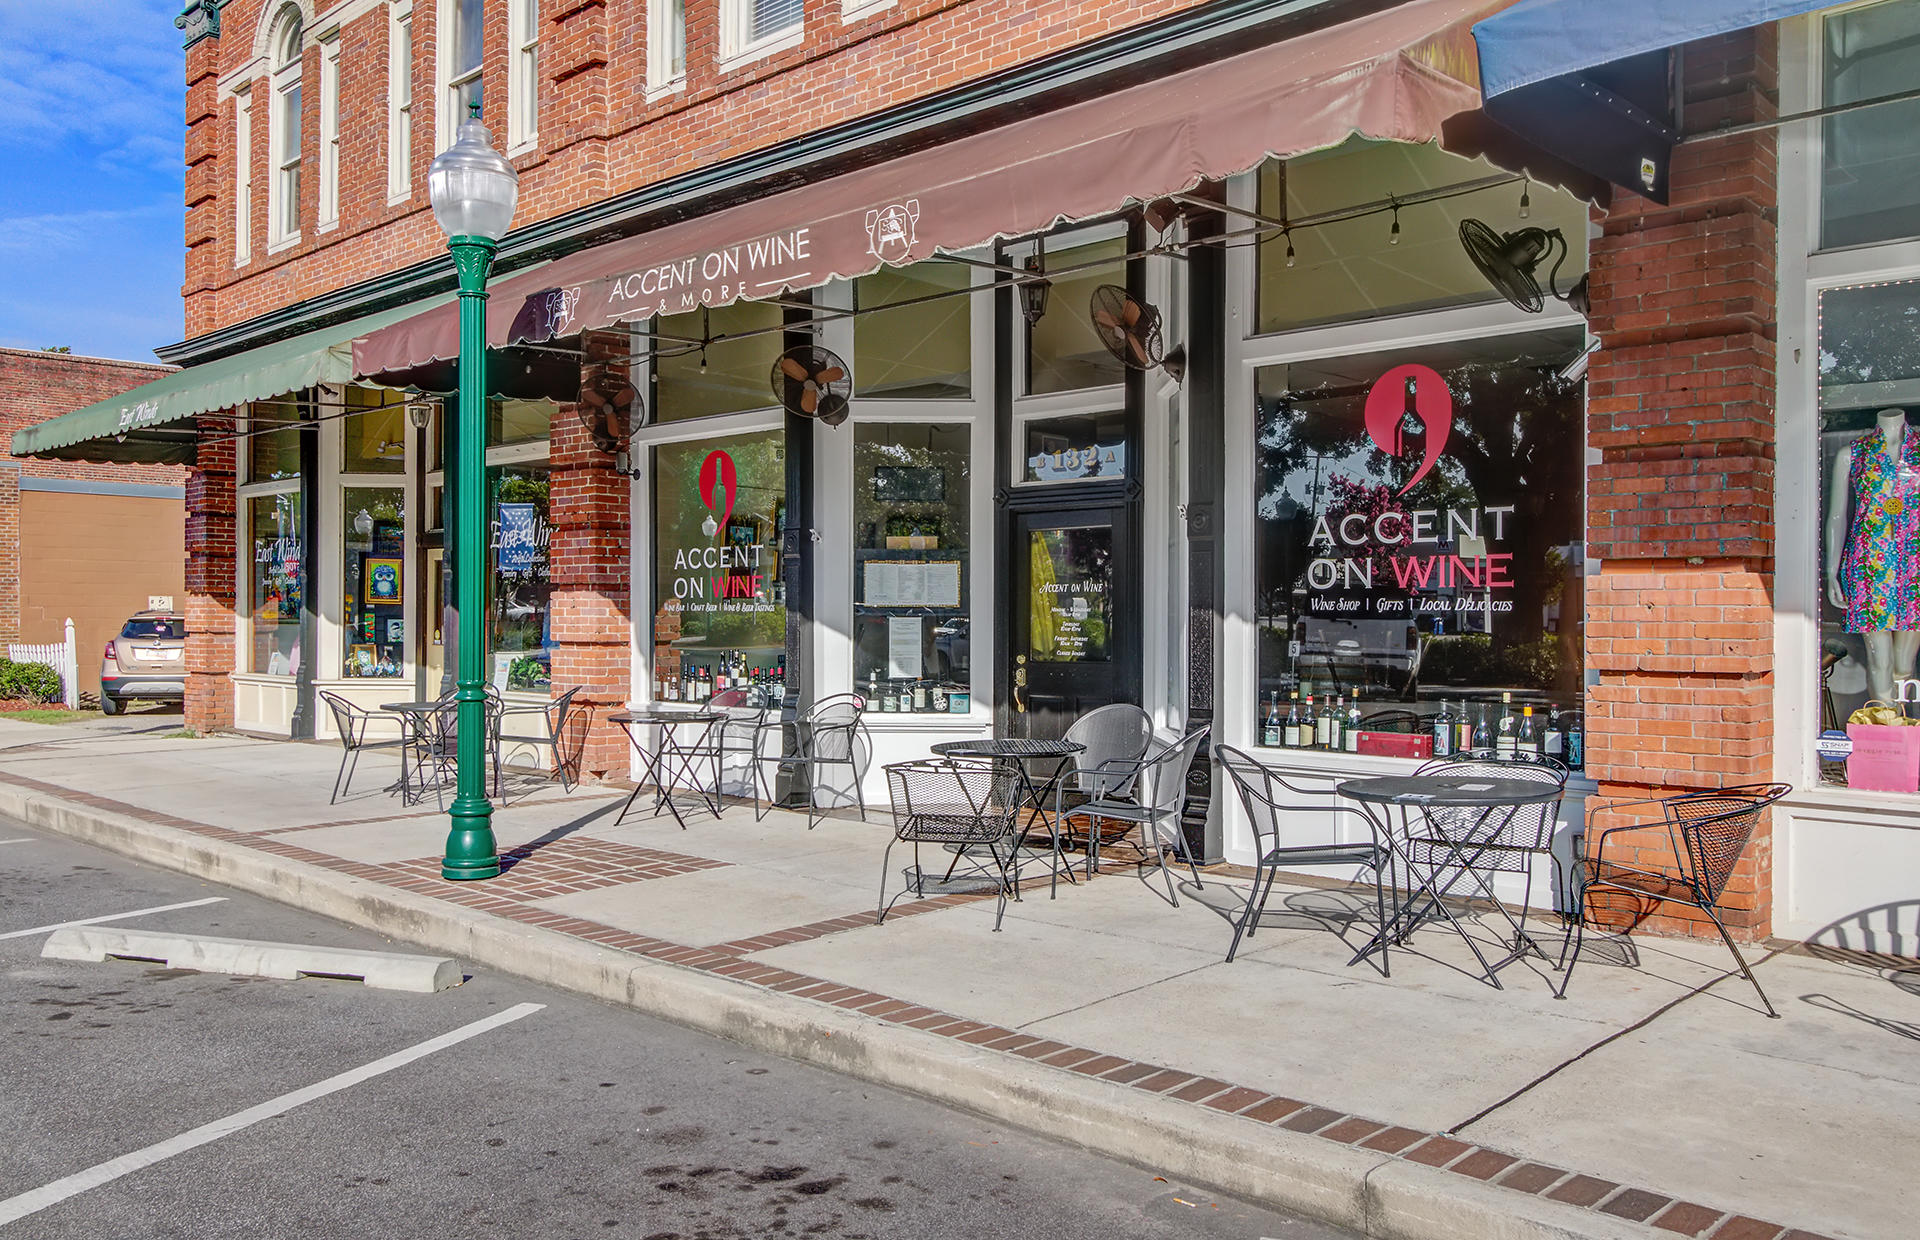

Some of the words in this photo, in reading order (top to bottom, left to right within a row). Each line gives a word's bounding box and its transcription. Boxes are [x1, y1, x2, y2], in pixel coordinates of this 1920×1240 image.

[608, 257, 697, 303] ACCENT
[702, 247, 739, 281] ON
[747, 228, 811, 271] WINE
[660, 298, 667, 311] &
[681, 281, 747, 307] MORE
[1052, 446, 1099, 472] 132
[522, 515, 552, 547] Win
[1307, 504, 1515, 547] ACCENT
[274, 537, 301, 561] Wind
[674, 544, 765, 570] ACCENT
[1307, 557, 1373, 590] ON
[1389, 552, 1515, 589] WINE
[673, 576, 704, 599] ON
[711, 574, 765, 598] WINE
[1039, 581, 1070, 593] ACCENT
[1071, 583, 1081, 592] ON
[1083, 577, 1104, 592] WINE
[1311, 594, 1335, 611] WINE
[1337, 597, 1361, 611] SHOP
[1376, 598, 1404, 612] GIFTS
[1419, 598, 1451, 611] LOCAL
[1455, 597, 1514, 612] DELICACIES
